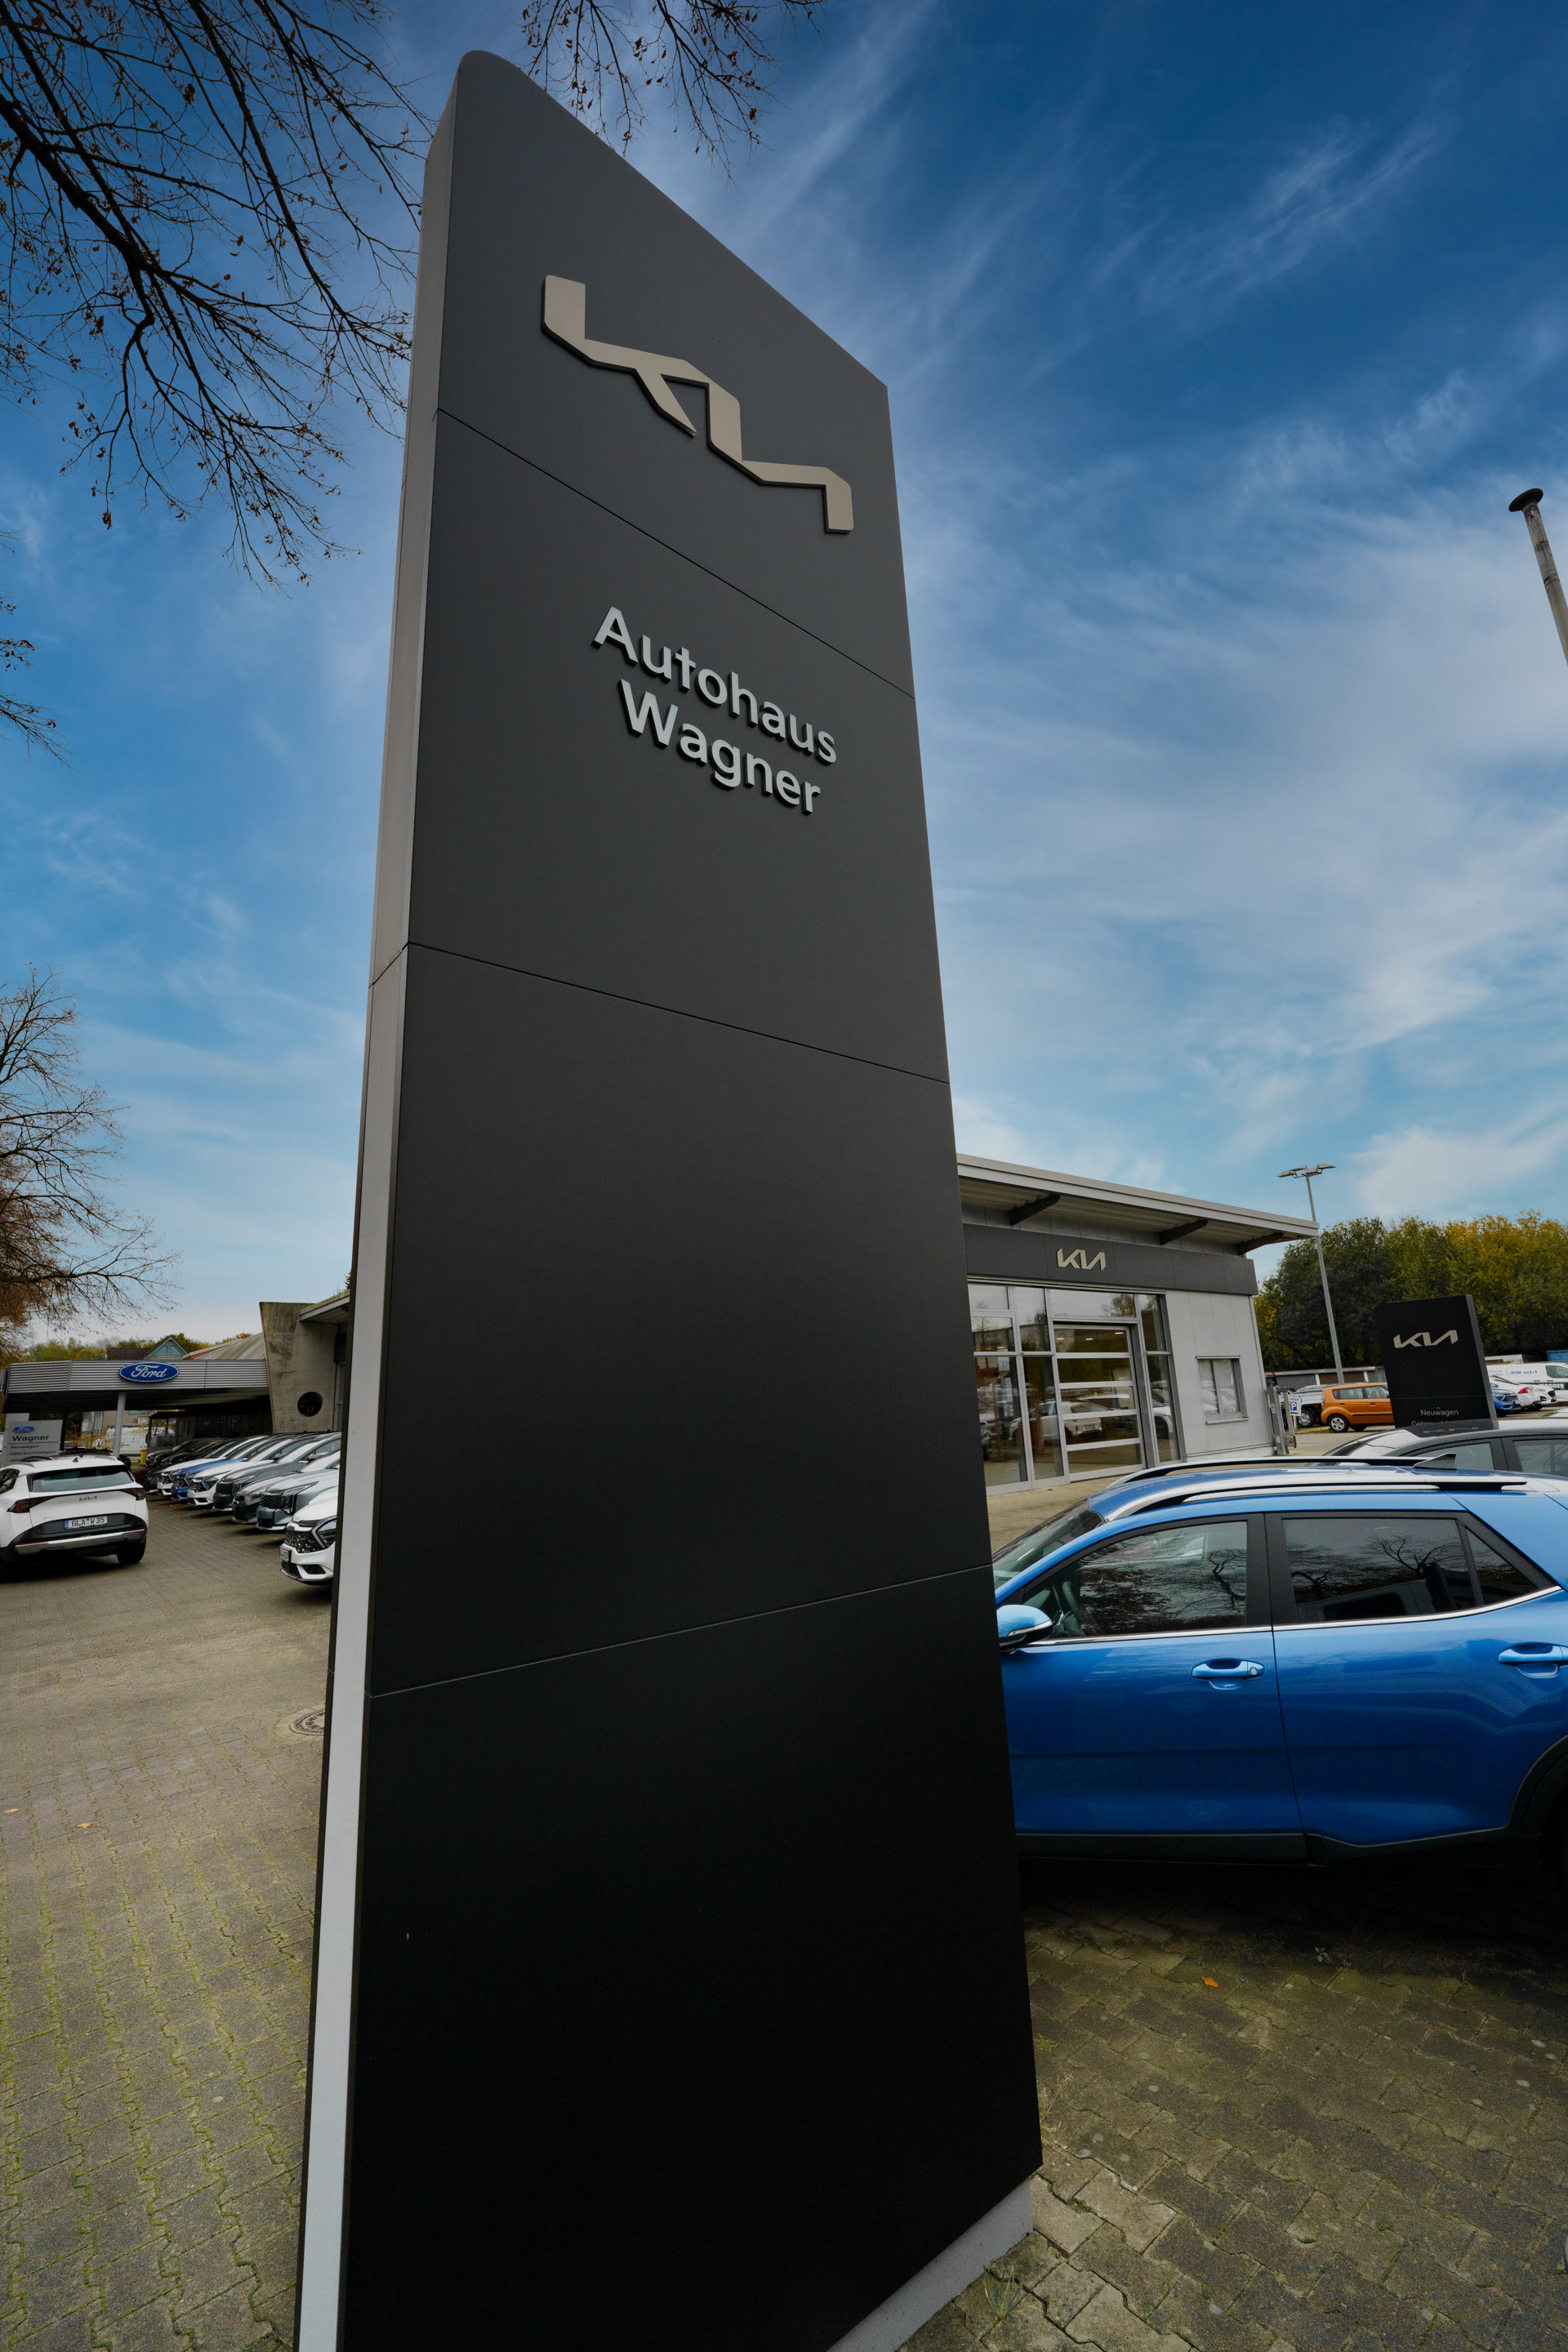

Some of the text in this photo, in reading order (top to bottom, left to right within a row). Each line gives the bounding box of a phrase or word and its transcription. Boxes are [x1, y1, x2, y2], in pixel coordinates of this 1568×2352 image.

[541, 274, 854, 534] KIA
[591, 606, 837, 764] Autohaus
[621, 679, 821, 816] Wagner
[1056, 1247, 1107, 1272] KIA
[1392, 1330, 1459, 1348] KIA
[131, 1365, 168, 1378] Ford
[1291, 1402, 1297, 1410] P
